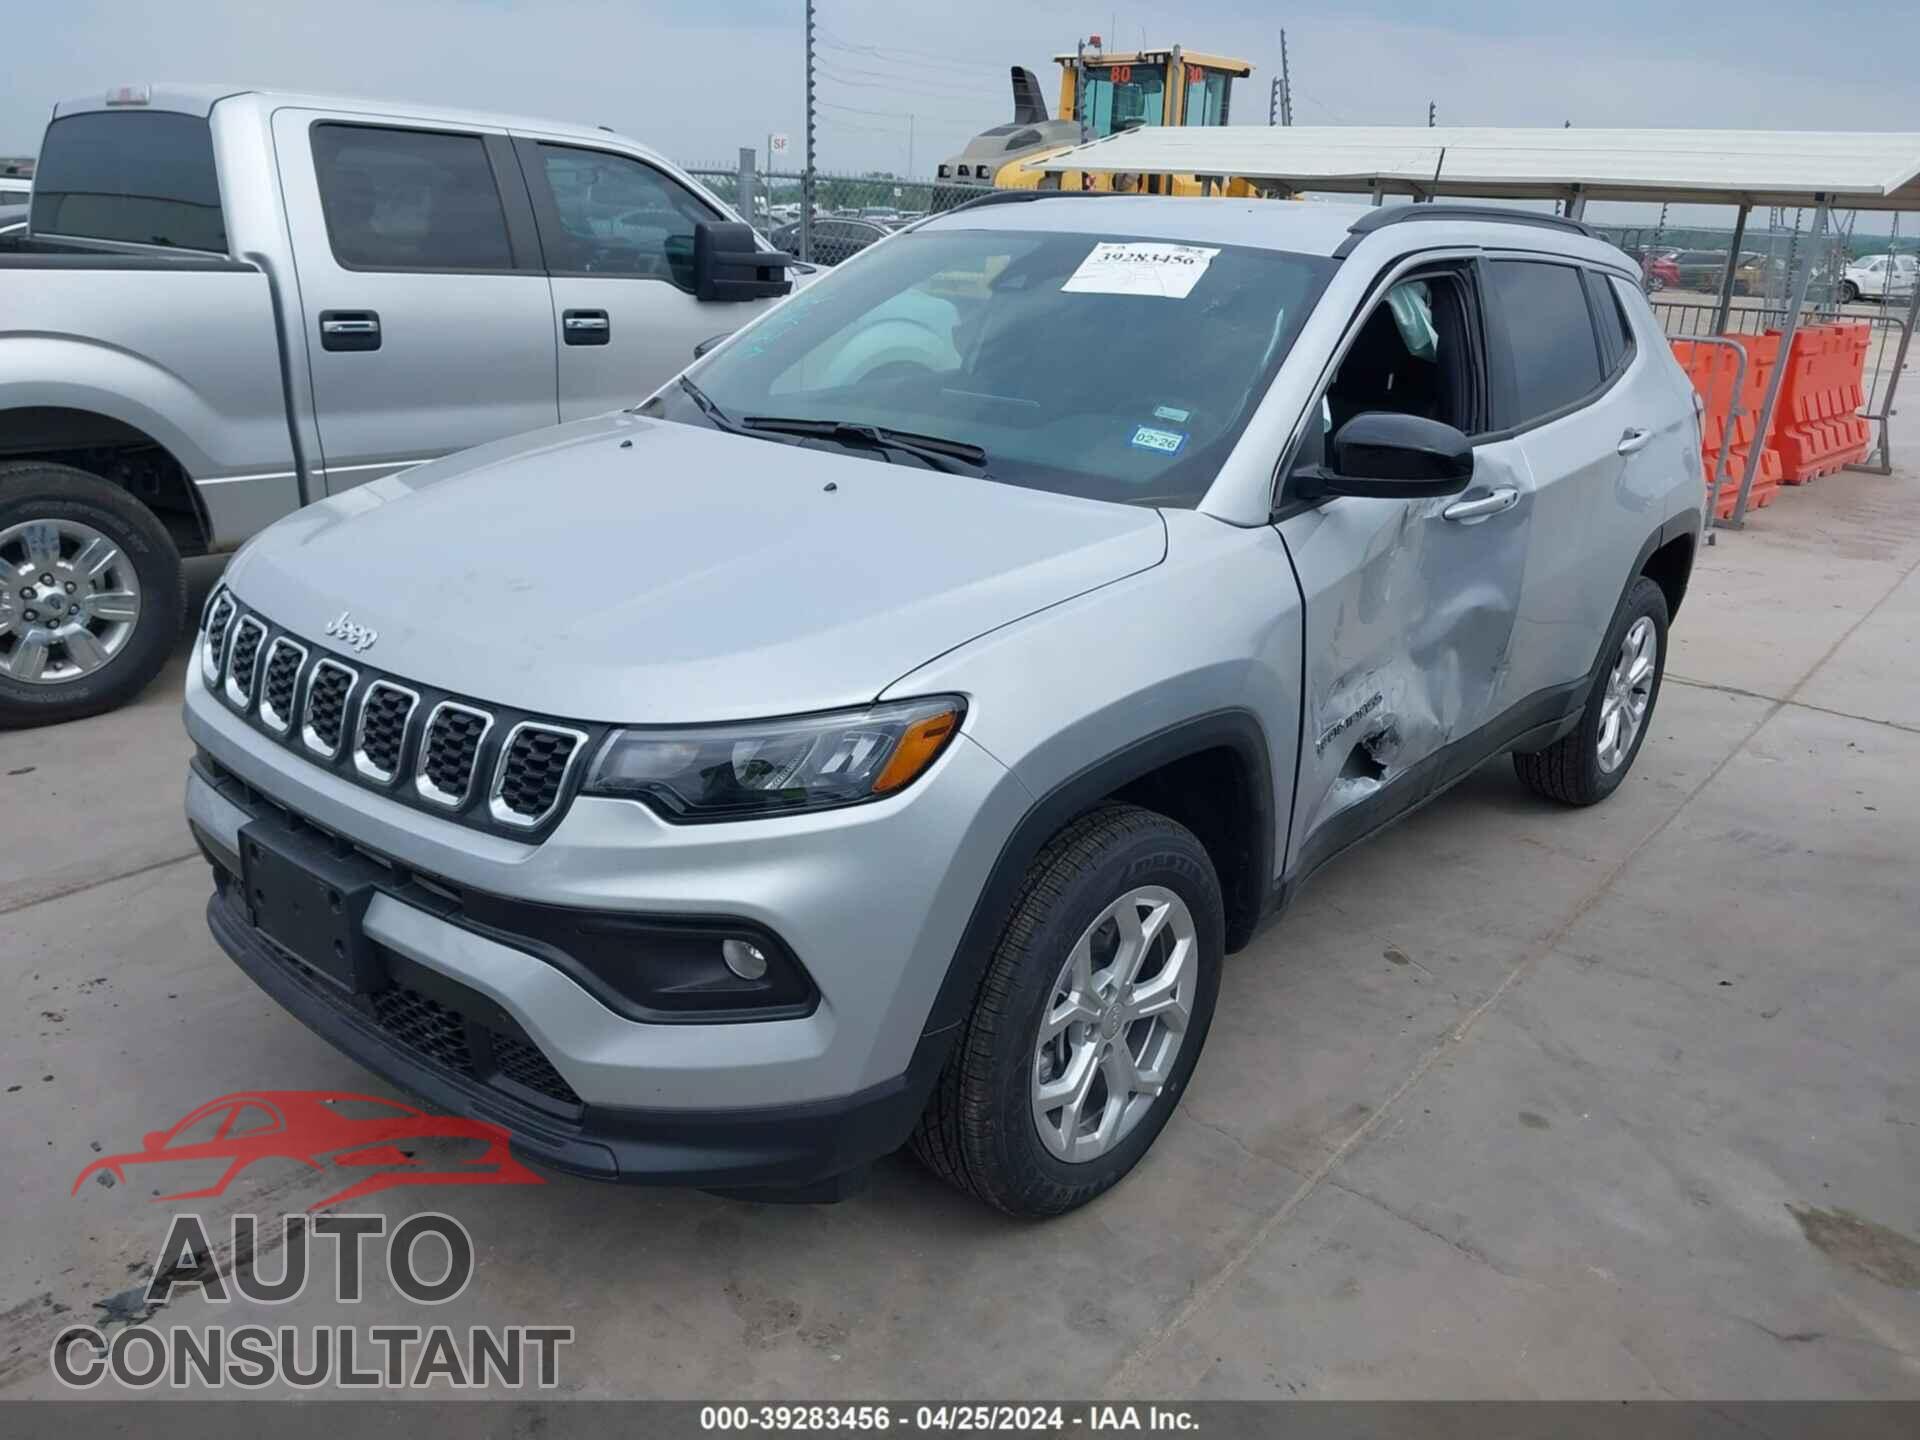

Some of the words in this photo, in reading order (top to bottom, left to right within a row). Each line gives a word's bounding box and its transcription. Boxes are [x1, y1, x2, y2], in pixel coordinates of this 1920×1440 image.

[1110, 65, 1131, 83] 80
[774, 138, 787, 150] SF
[325, 611, 378, 654] Jeep
